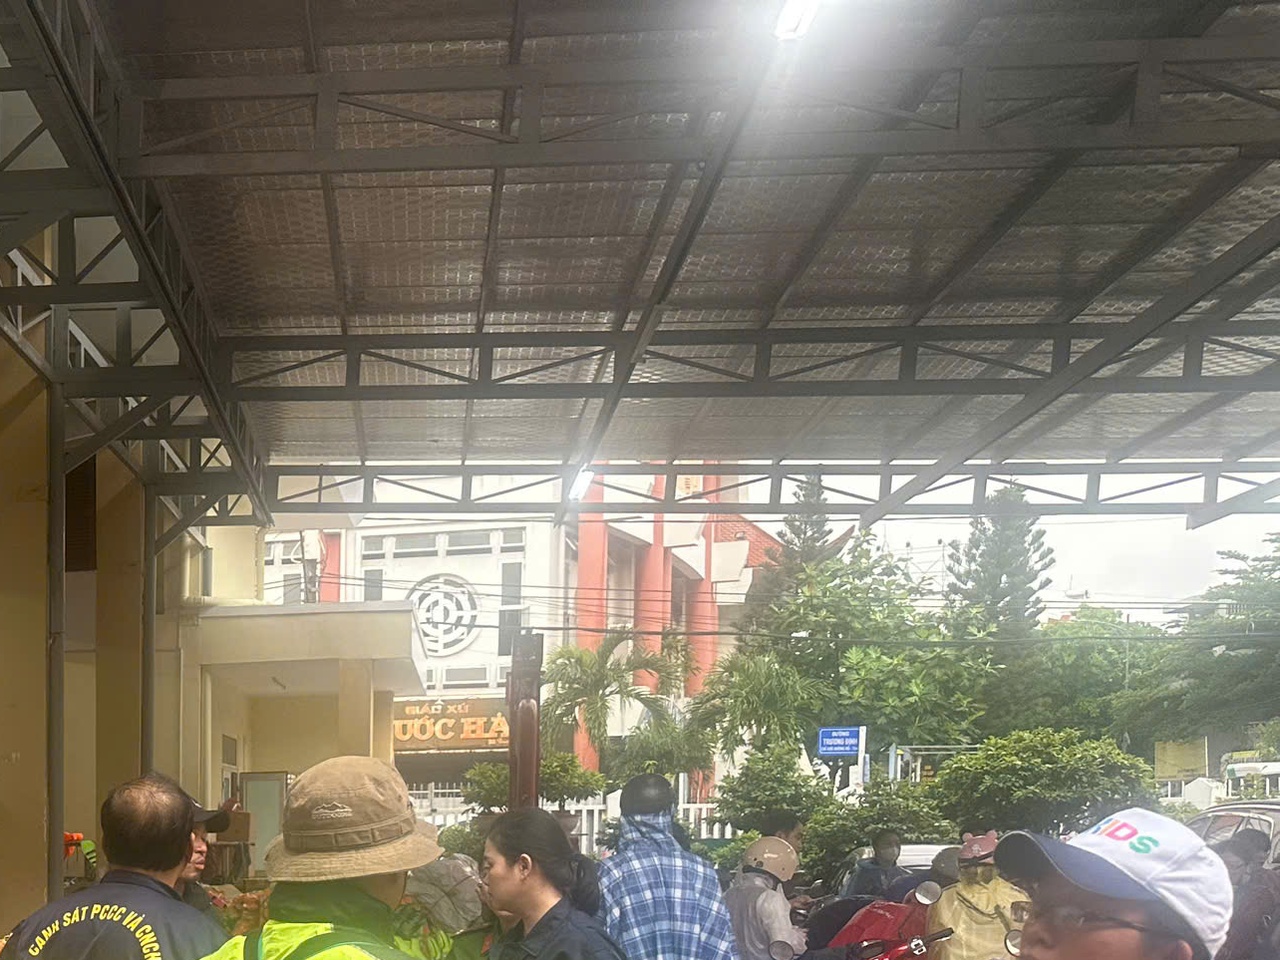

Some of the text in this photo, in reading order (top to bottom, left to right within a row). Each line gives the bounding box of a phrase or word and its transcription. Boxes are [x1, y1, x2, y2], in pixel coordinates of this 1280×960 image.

[393, 712, 509, 740] ƯỚC HẢ
[90, 904, 127, 922] PCCC
